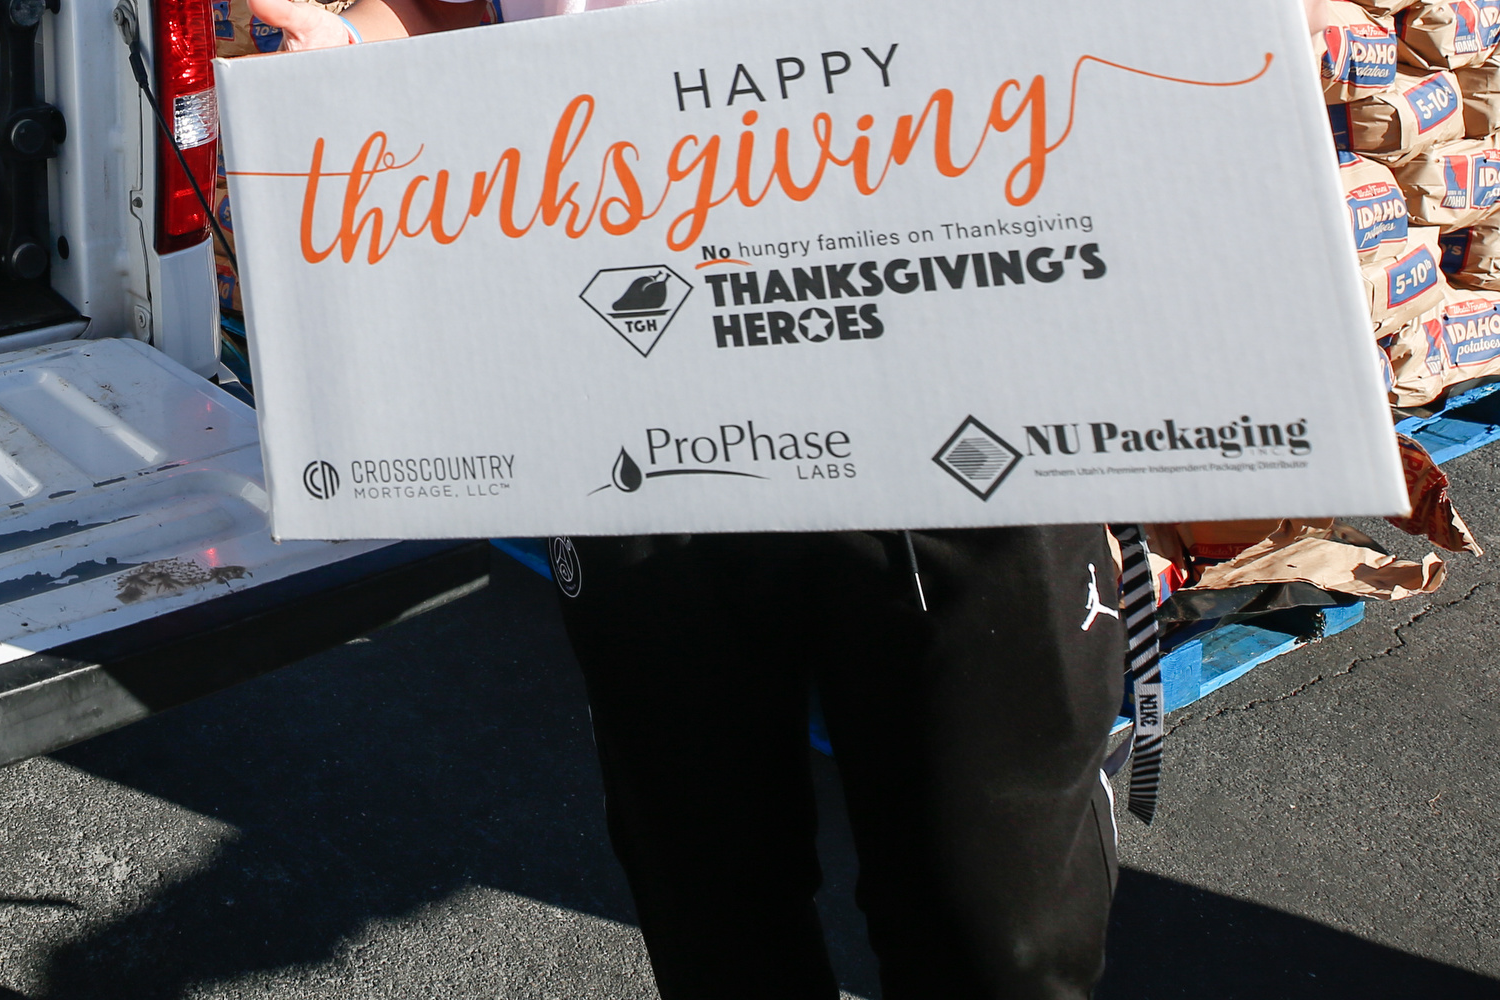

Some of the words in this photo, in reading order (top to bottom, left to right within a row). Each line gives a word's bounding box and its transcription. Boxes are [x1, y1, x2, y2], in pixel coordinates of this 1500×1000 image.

[673, 42, 900, 112] HAPPY
[297, 56, 1110, 266] thanksgiving
[1356, 198, 1406, 229] IDAHO
[701, 245, 732, 261] No
[738, 238, 810, 259] hungry
[816, 230, 900, 251] families
[908, 226, 934, 243] on
[940, 214, 1094, 240] Thanksgiving
[705, 243, 1107, 308] THANKSGIVING'S
[625, 319, 658, 333] TGH
[712, 303, 885, 348] HEROES
[1446, 313, 1500, 345] IDAHO
[1456, 336, 1500, 363] potatoes
[645, 420, 852, 465] ProPhase
[1021, 423, 1080, 456] NU
[1088, 415, 1312, 459] Packaging
[351, 454, 515, 484] CROSSCOUNTRY
[796, 463, 857, 480] LABS
[1034, 468, 1076, 478] Northern
[1077, 467, 1106, 477] Utah's
[1149, 464, 1208, 474] Independent
[1209, 463, 1256, 473] Packaging
[1257, 460, 1309, 470] Distributor
[1139, 693, 1158, 728] NIKE
